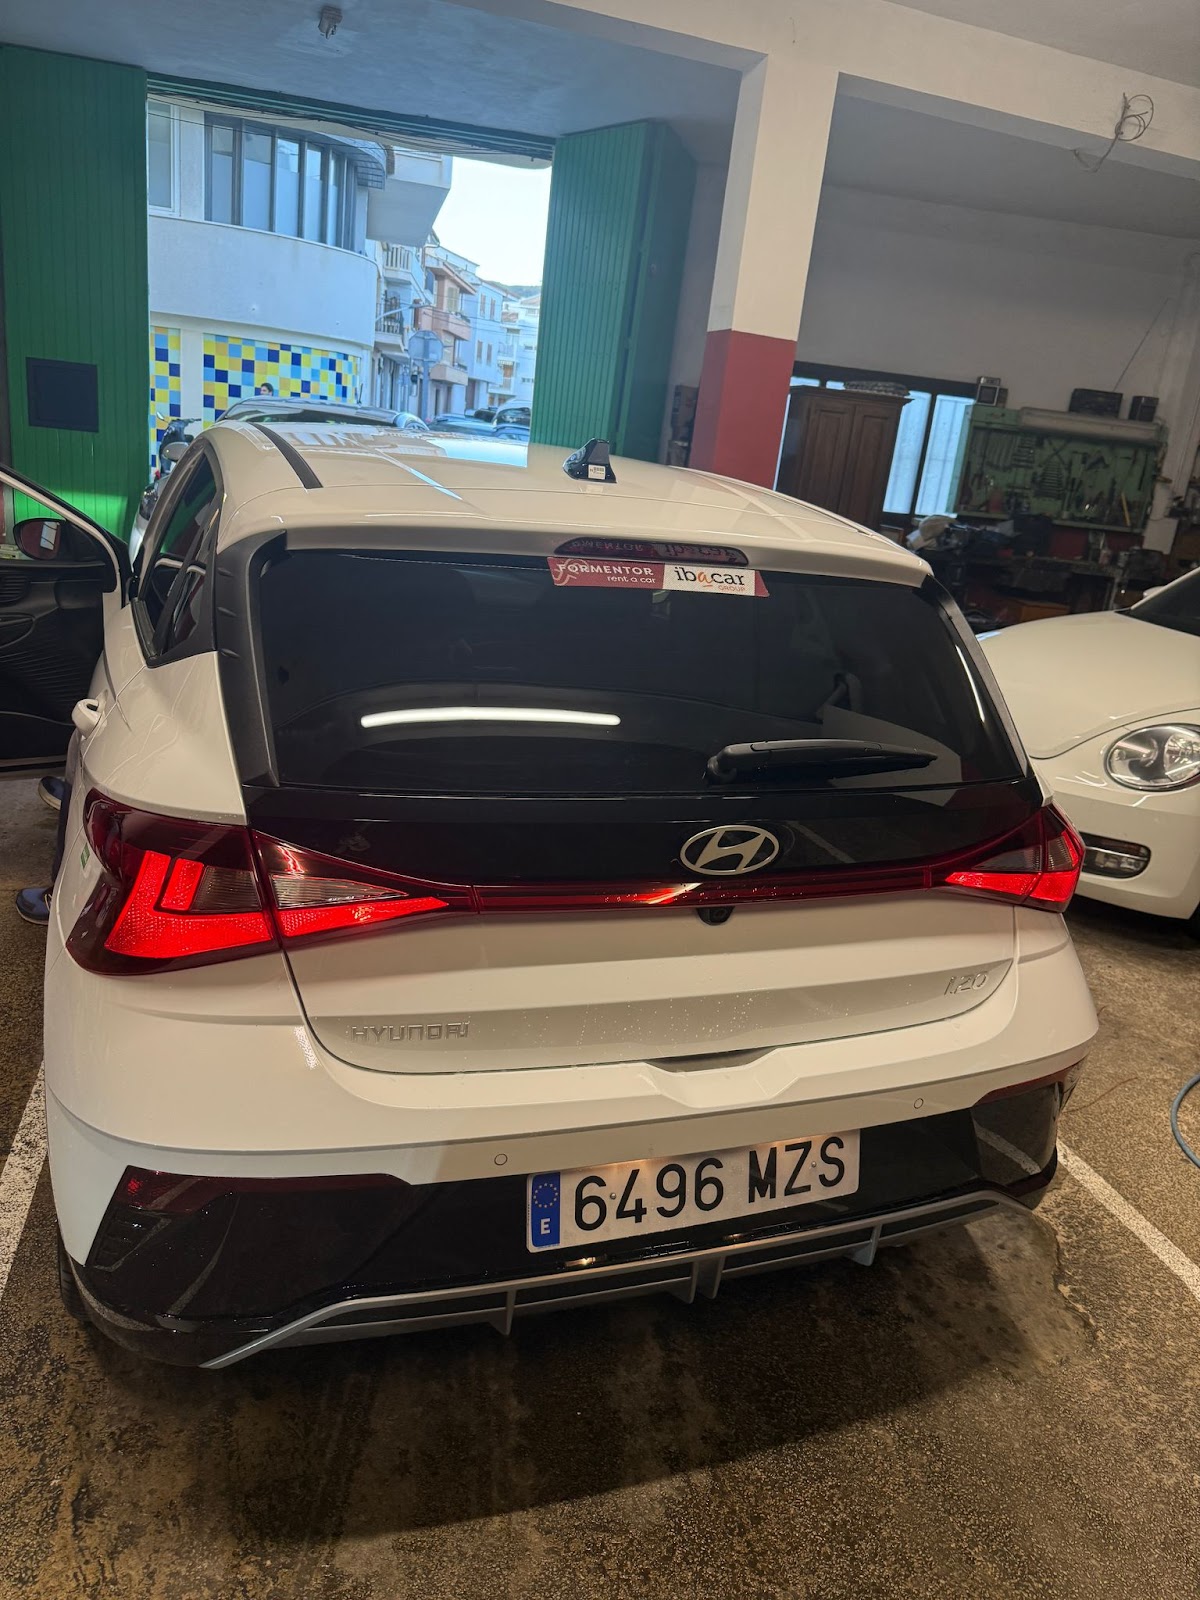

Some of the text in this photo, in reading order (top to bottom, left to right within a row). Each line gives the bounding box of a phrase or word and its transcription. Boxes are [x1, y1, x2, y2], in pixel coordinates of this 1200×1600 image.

[556, 563, 654, 576] FORMENTOR
[607, 575, 629, 583] rent
[674, 566, 745, 586] ibacar
[351, 1021, 470, 1042] HYUNDAI
[574, 1136, 845, 1231] 6496 MZS
[540, 1217, 551, 1235] E
